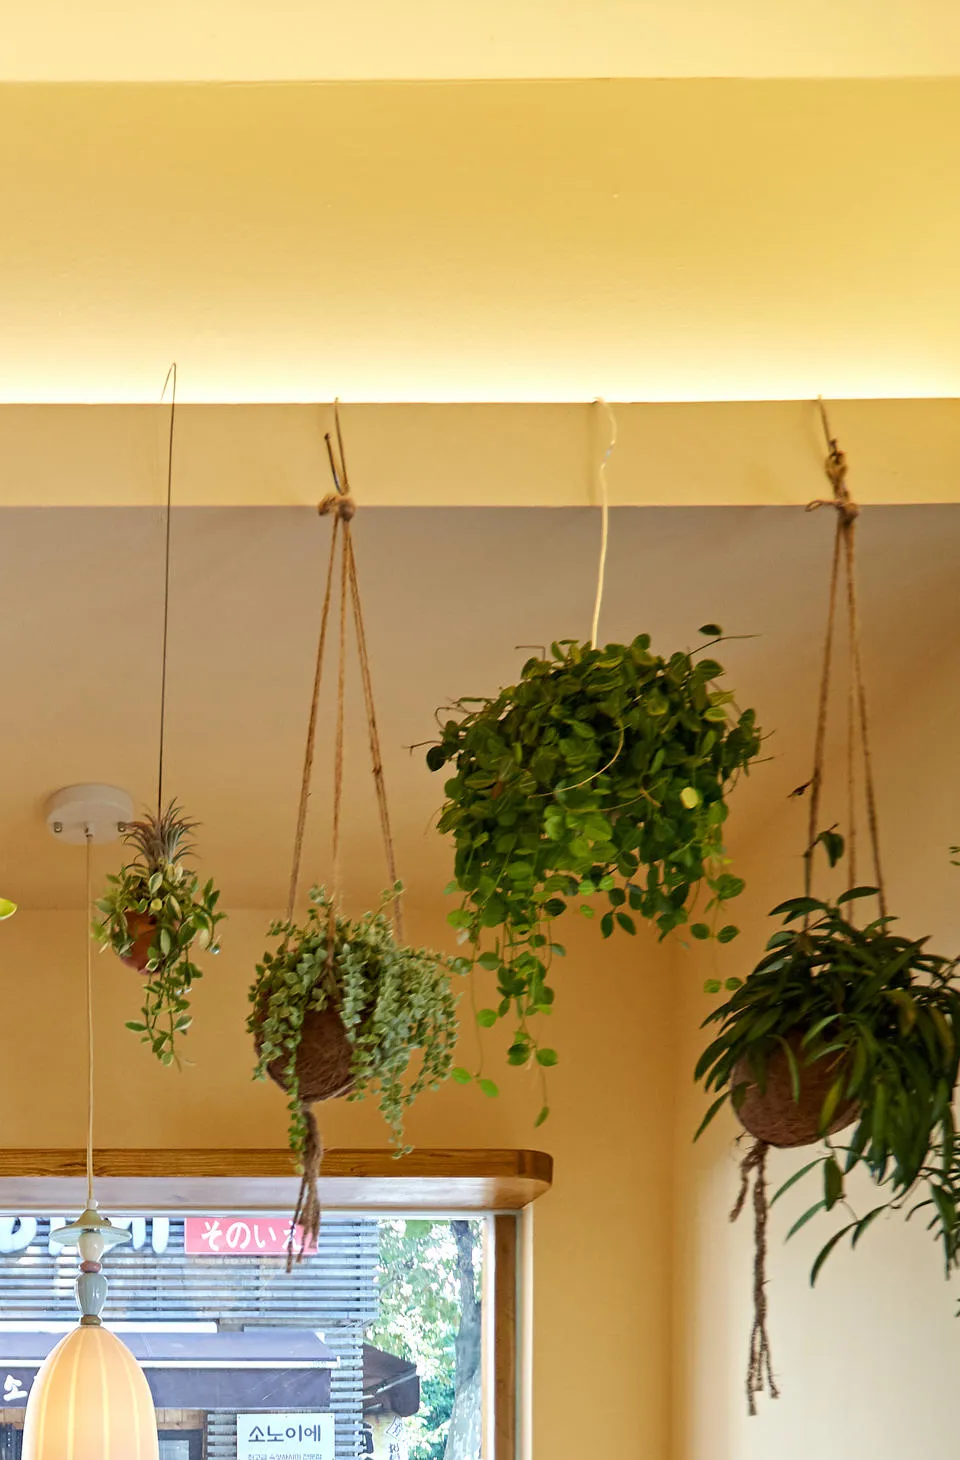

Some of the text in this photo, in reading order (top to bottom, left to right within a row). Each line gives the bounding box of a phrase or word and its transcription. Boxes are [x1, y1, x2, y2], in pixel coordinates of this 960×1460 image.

[201, 1220, 303, 1251] そのいえ
[248, 1424, 321, 1442] 소노이에
